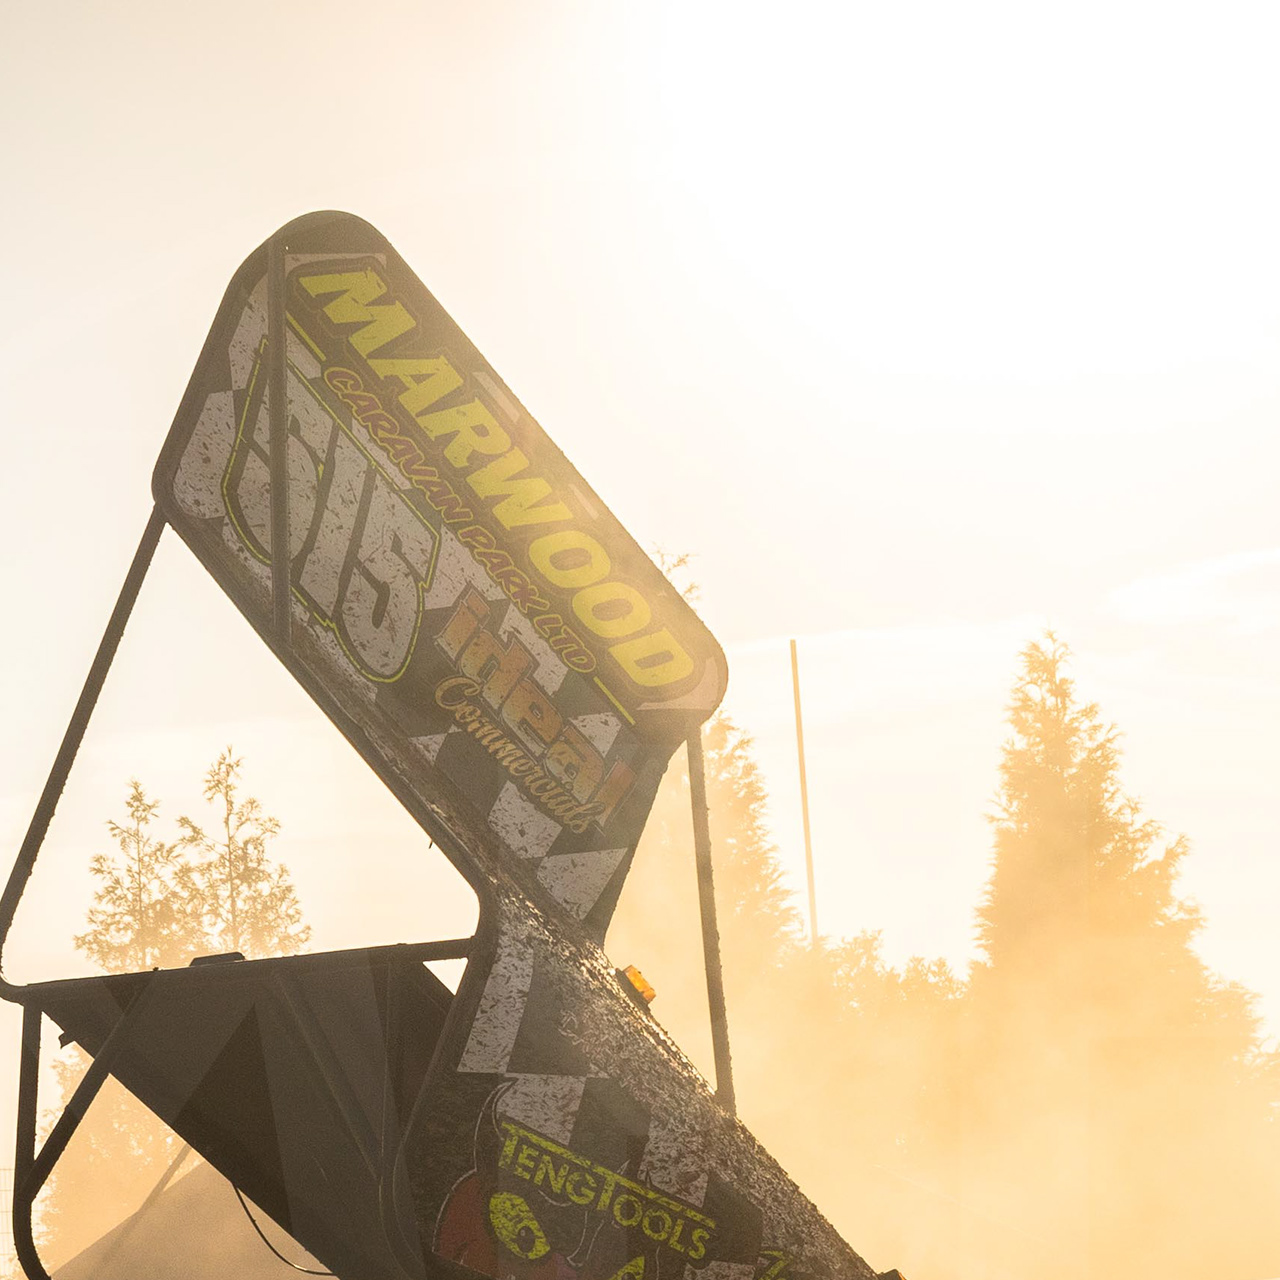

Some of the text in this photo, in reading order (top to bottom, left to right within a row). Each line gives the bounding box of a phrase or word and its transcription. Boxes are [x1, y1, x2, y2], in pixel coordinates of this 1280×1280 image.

[299, 267, 695, 690] MARWOOD
[323, 367, 598, 675] CARAVAN PARK LTD
[434, 676, 612, 836] Commercials
